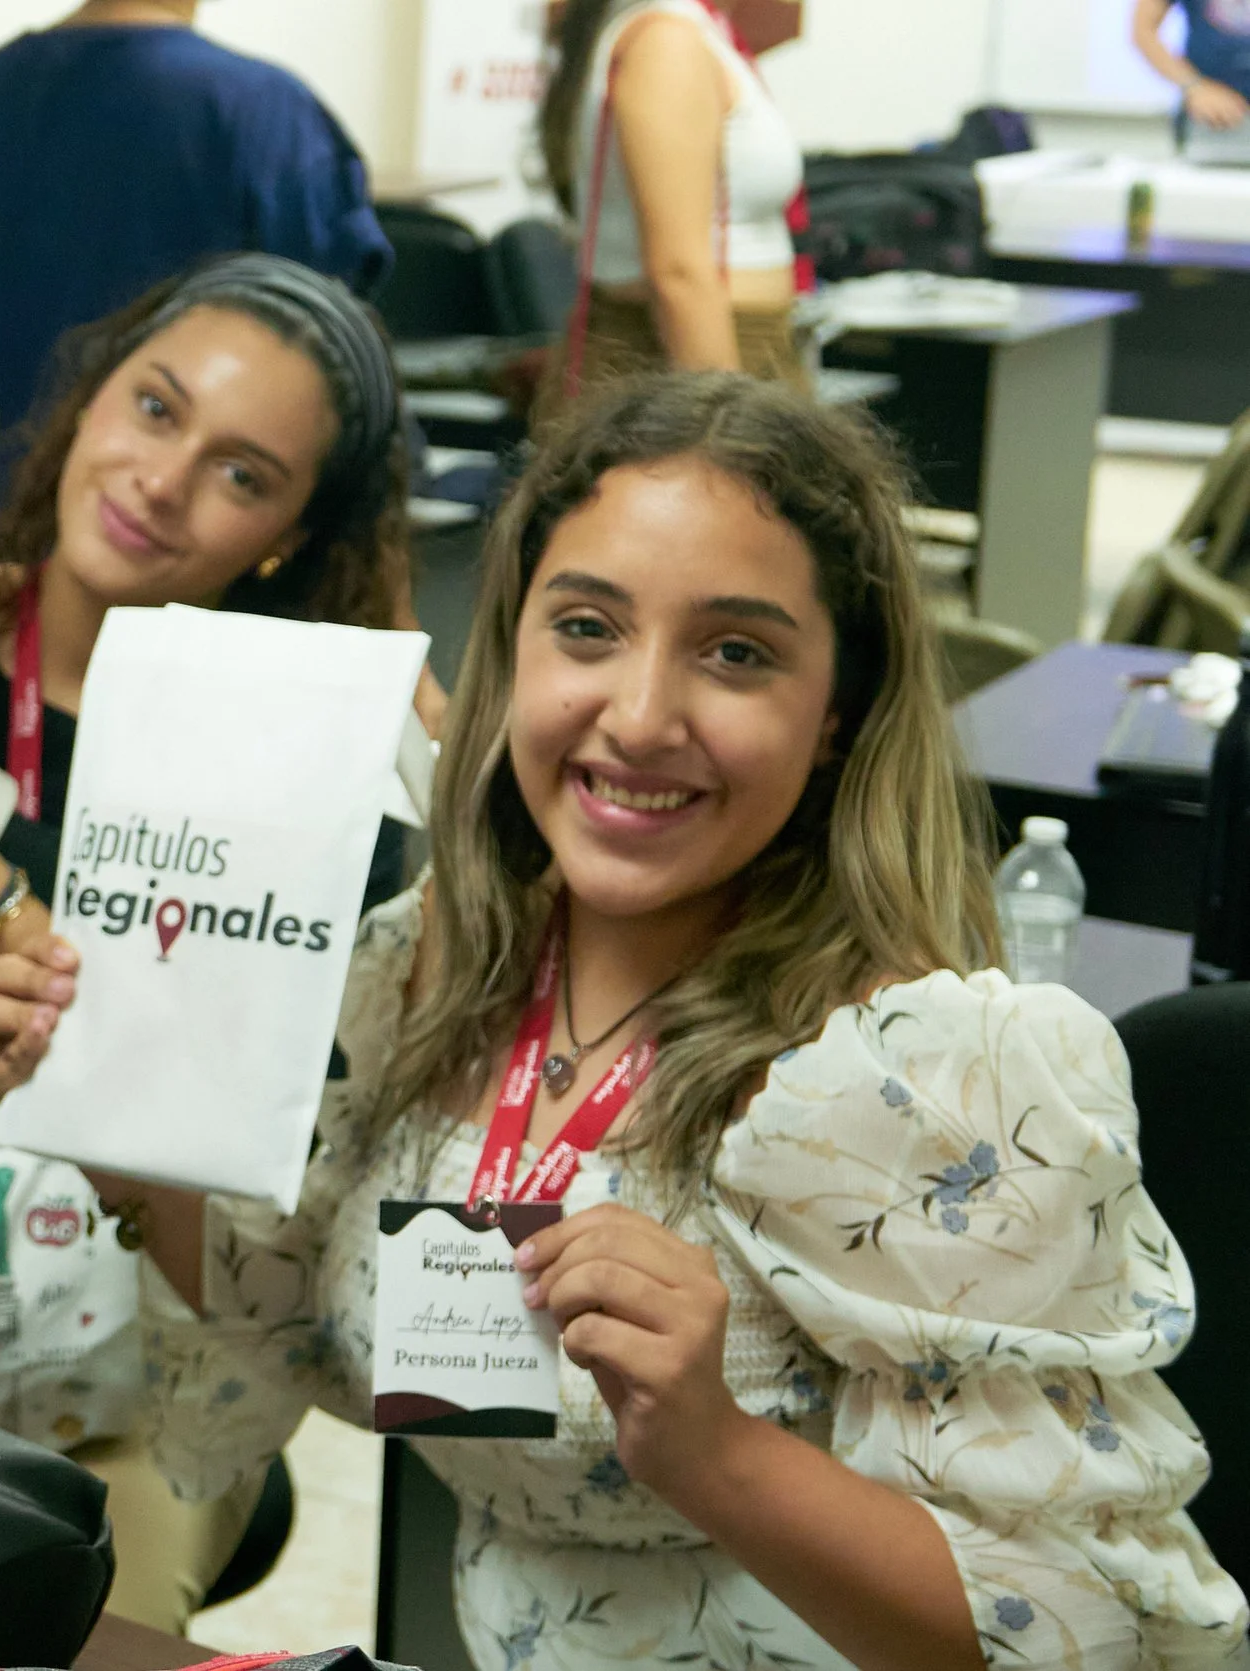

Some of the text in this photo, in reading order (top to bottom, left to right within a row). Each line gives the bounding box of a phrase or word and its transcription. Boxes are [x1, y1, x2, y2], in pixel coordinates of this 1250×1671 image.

[423, 1256, 516, 1280] Regionales
[394, 1348, 539, 1373] Persona Jueza
